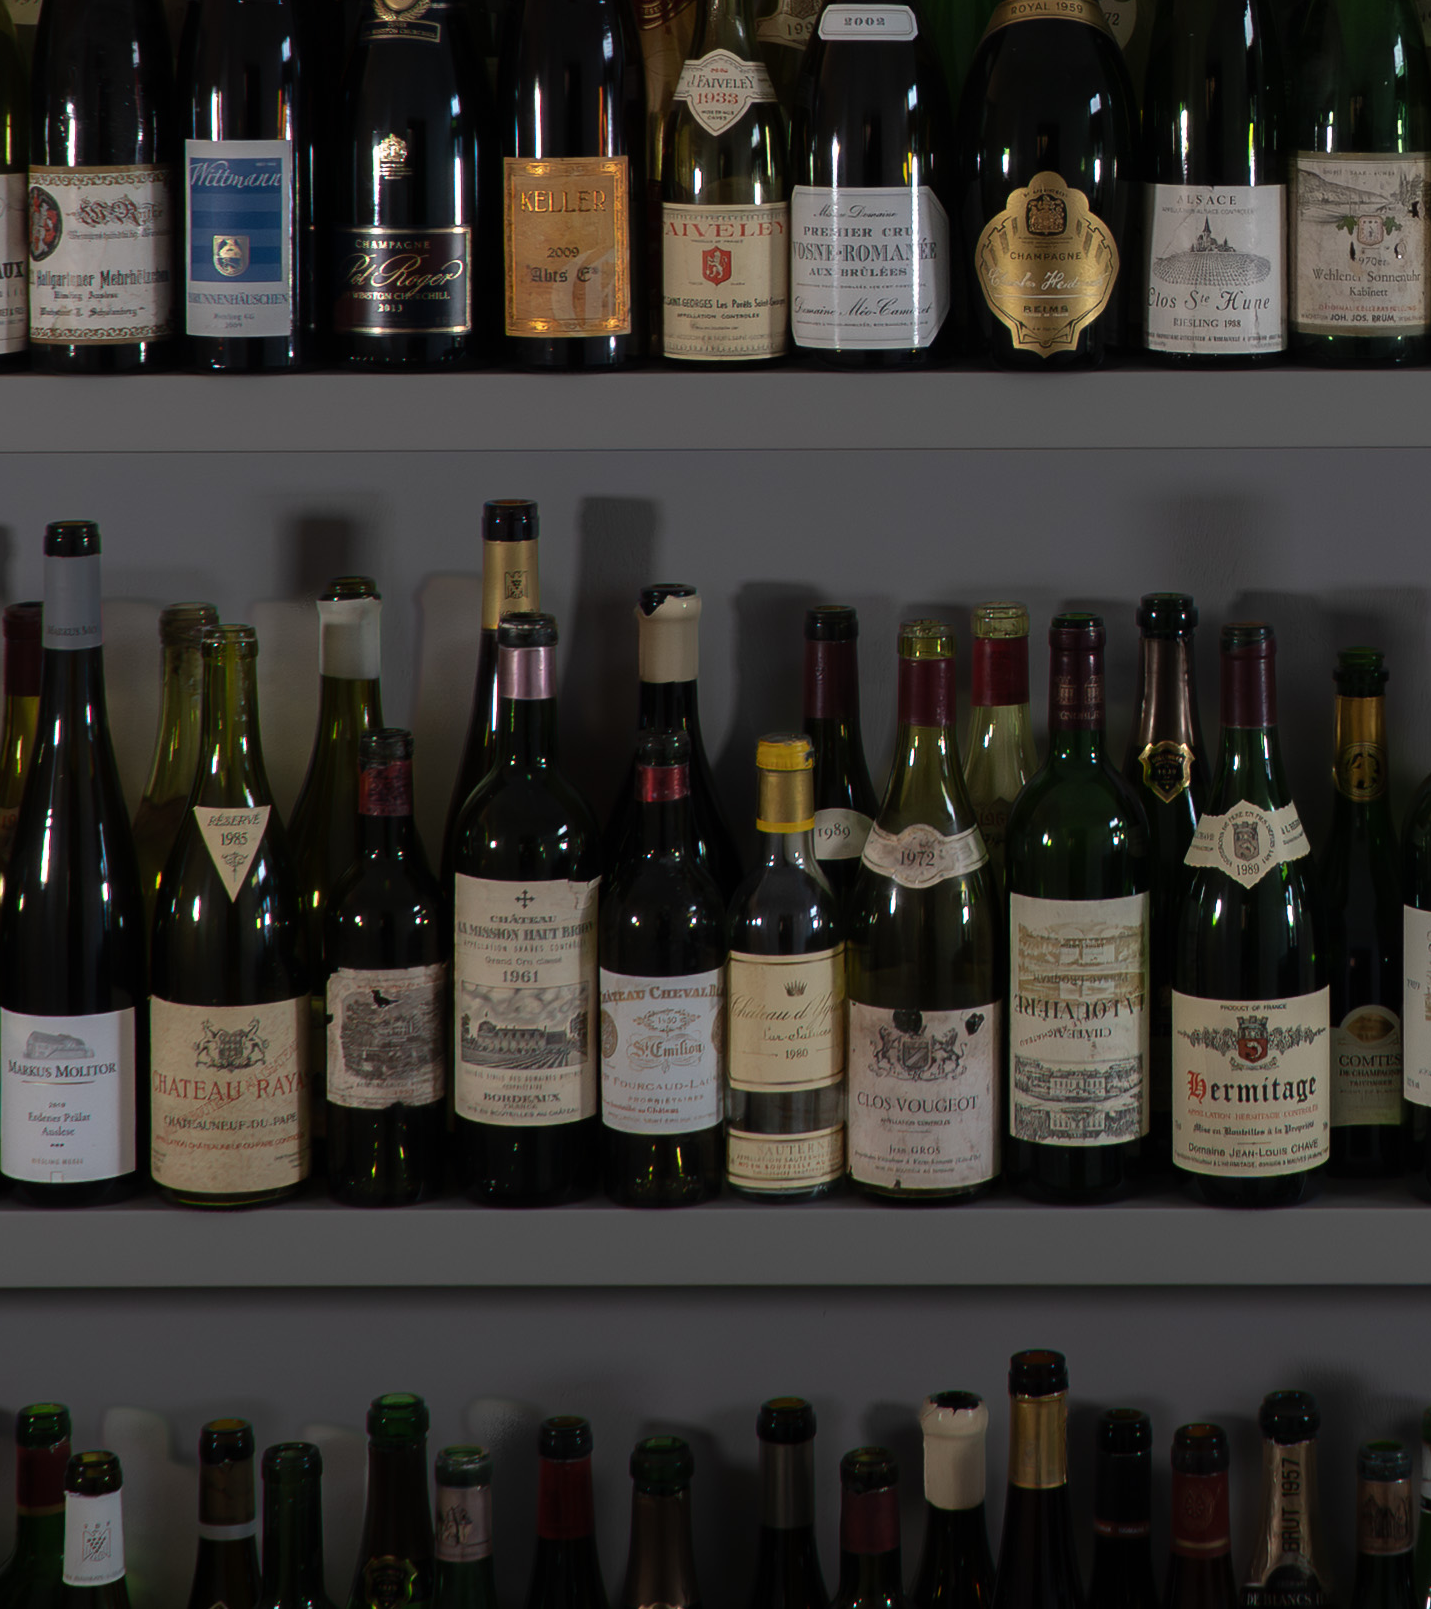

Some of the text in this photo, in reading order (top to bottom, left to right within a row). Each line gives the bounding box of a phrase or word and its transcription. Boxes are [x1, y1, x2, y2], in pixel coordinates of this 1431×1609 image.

[1010, 1, 1085, 16] ROYAL 1959
[843, 15, 886, 27] 2002
[696, 91, 739, 106] 1933
[519, 188, 608, 215] KELLER
[1146, 290, 1181, 313] Clos
[220, 831, 248, 847] 1985
[817, 823, 852, 841] 1989
[898, 849, 936, 868] 1972
[1234, 862, 1260, 876] 1989
[474, 921, 520, 941] MISSION
[500, 968, 541, 983] 1961
[7, 1059, 118, 1078] MARKUS MOLITOR
[1187, 1070, 1318, 1107] Hermitage
